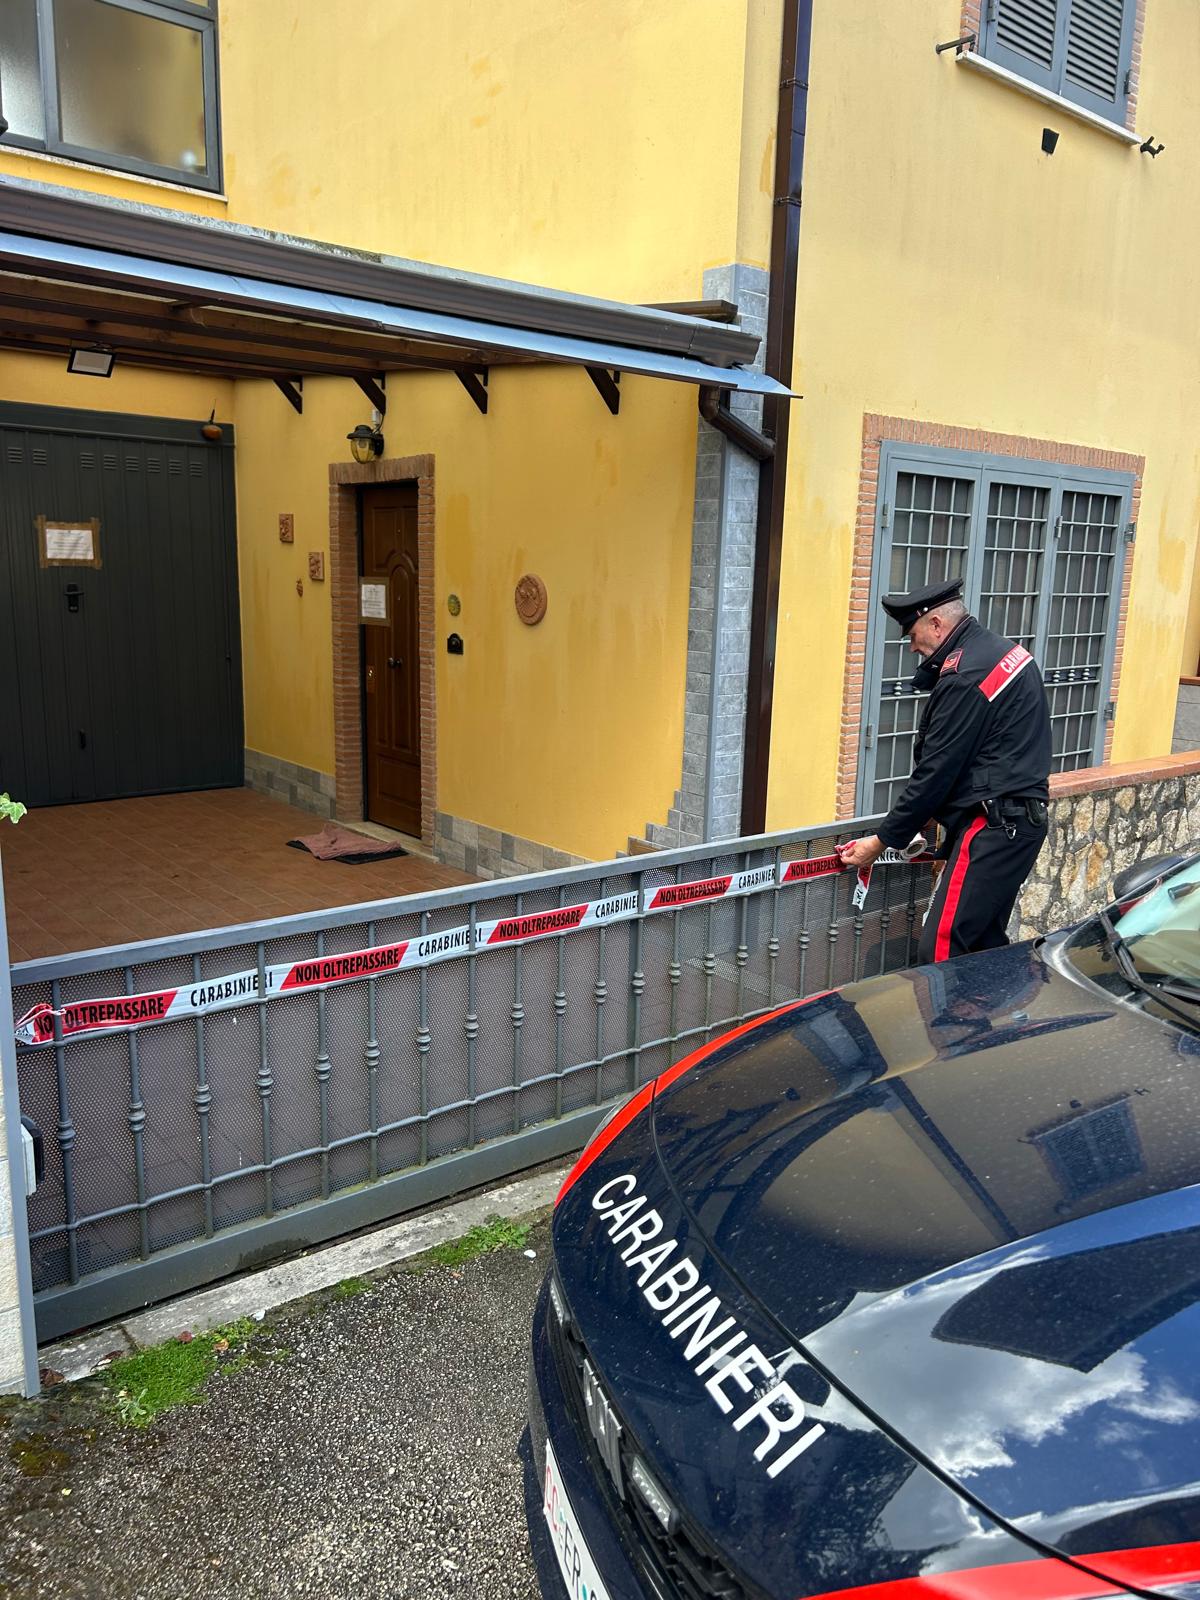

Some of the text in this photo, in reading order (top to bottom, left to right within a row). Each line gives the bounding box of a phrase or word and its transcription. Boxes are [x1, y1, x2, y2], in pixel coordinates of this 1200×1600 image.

[65, 996, 165, 1028] OLTREPASSARE
[295, 964, 320, 983] NON
[323, 948, 399, 978] OLTREPASSARE
[500, 921, 520, 937] NON
[522, 909, 580, 934] OLTREPASSARE
[595, 894, 640, 918] CARABINIE
[660, 888, 677, 903] NON
[678, 879, 727, 900] OLTREPASSARE
[738, 868, 776, 889] CARABINIER
[791, 863, 805, 877] NON
[592, 1174, 826, 1479] CARABINIERI
[564, 1521, 581, 1600] ER
